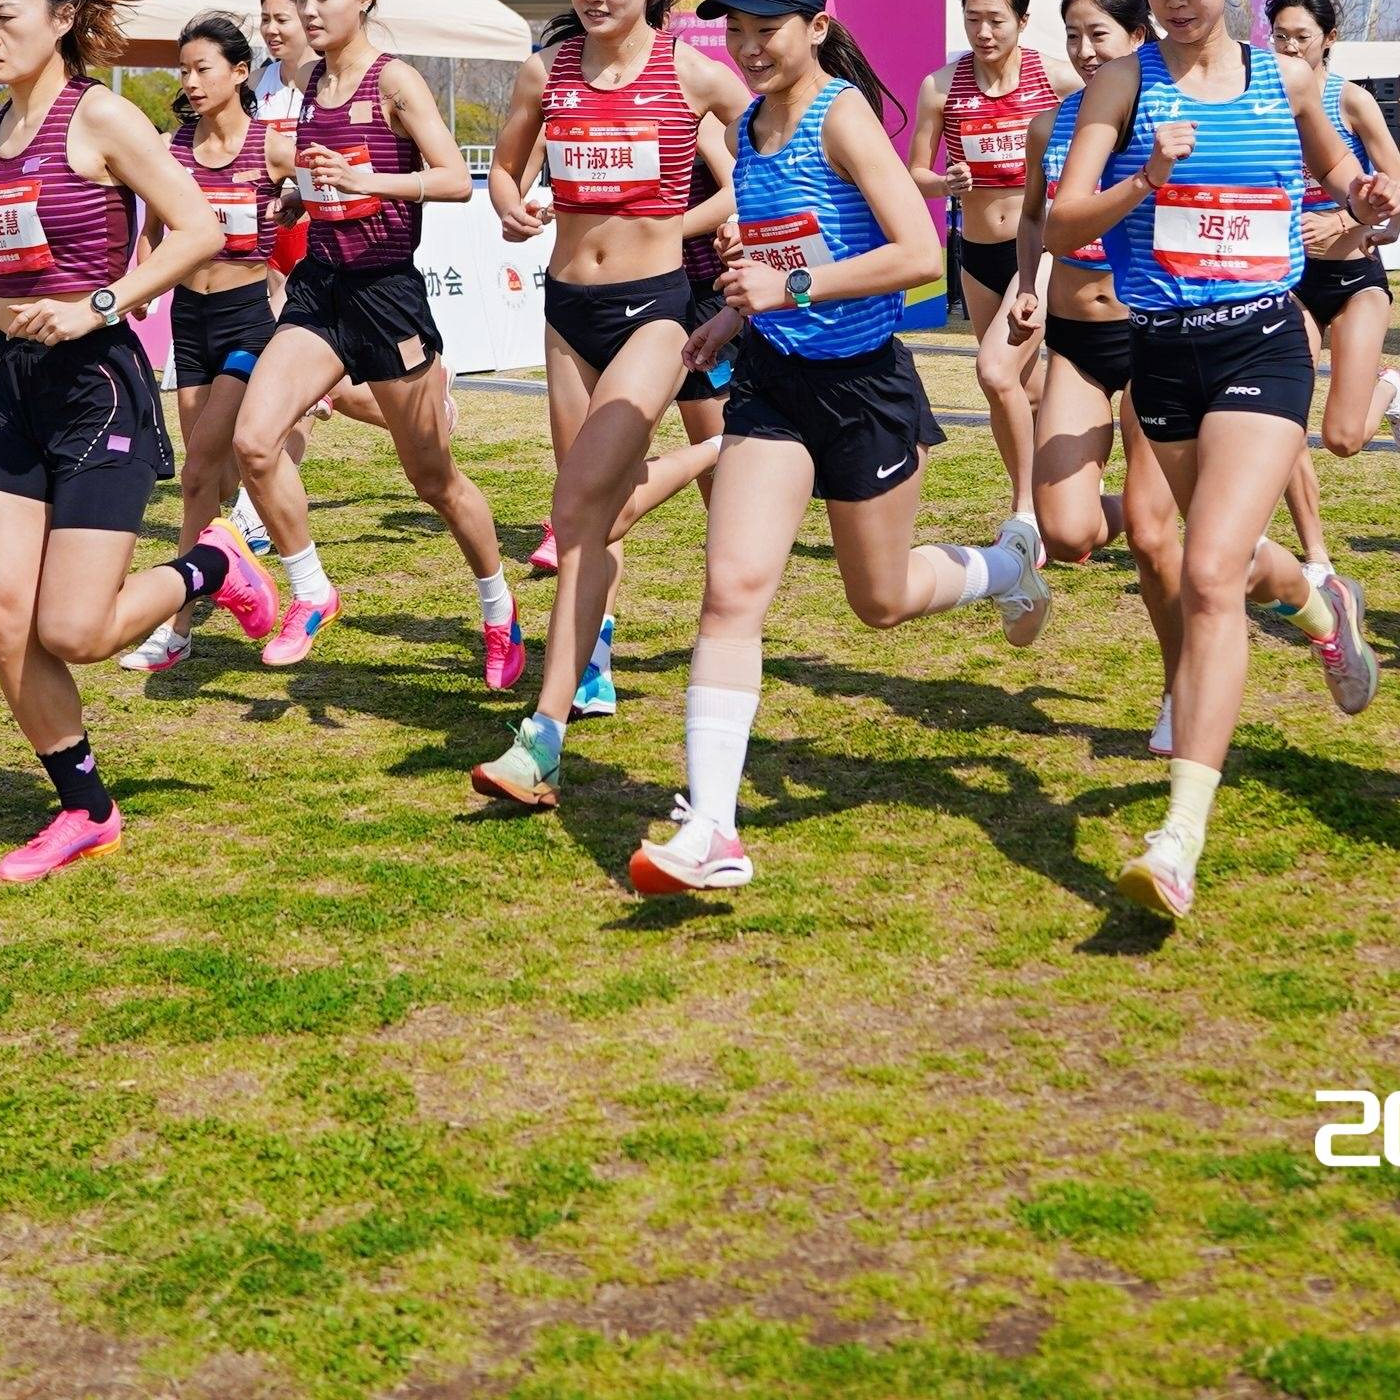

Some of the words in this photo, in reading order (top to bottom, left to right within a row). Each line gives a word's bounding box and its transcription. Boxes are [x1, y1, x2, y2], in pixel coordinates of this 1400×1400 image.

[563, 146, 634, 170] 叶淑琪
[591, 172, 607, 180] 227
[1216, 244, 1233, 254] 216
[1183, 310, 1229, 328] NIKE
[1231, 297, 1274, 319] PRO
[1225, 386, 1262, 396] PRO
[1141, 415, 1167, 426] NIKE
